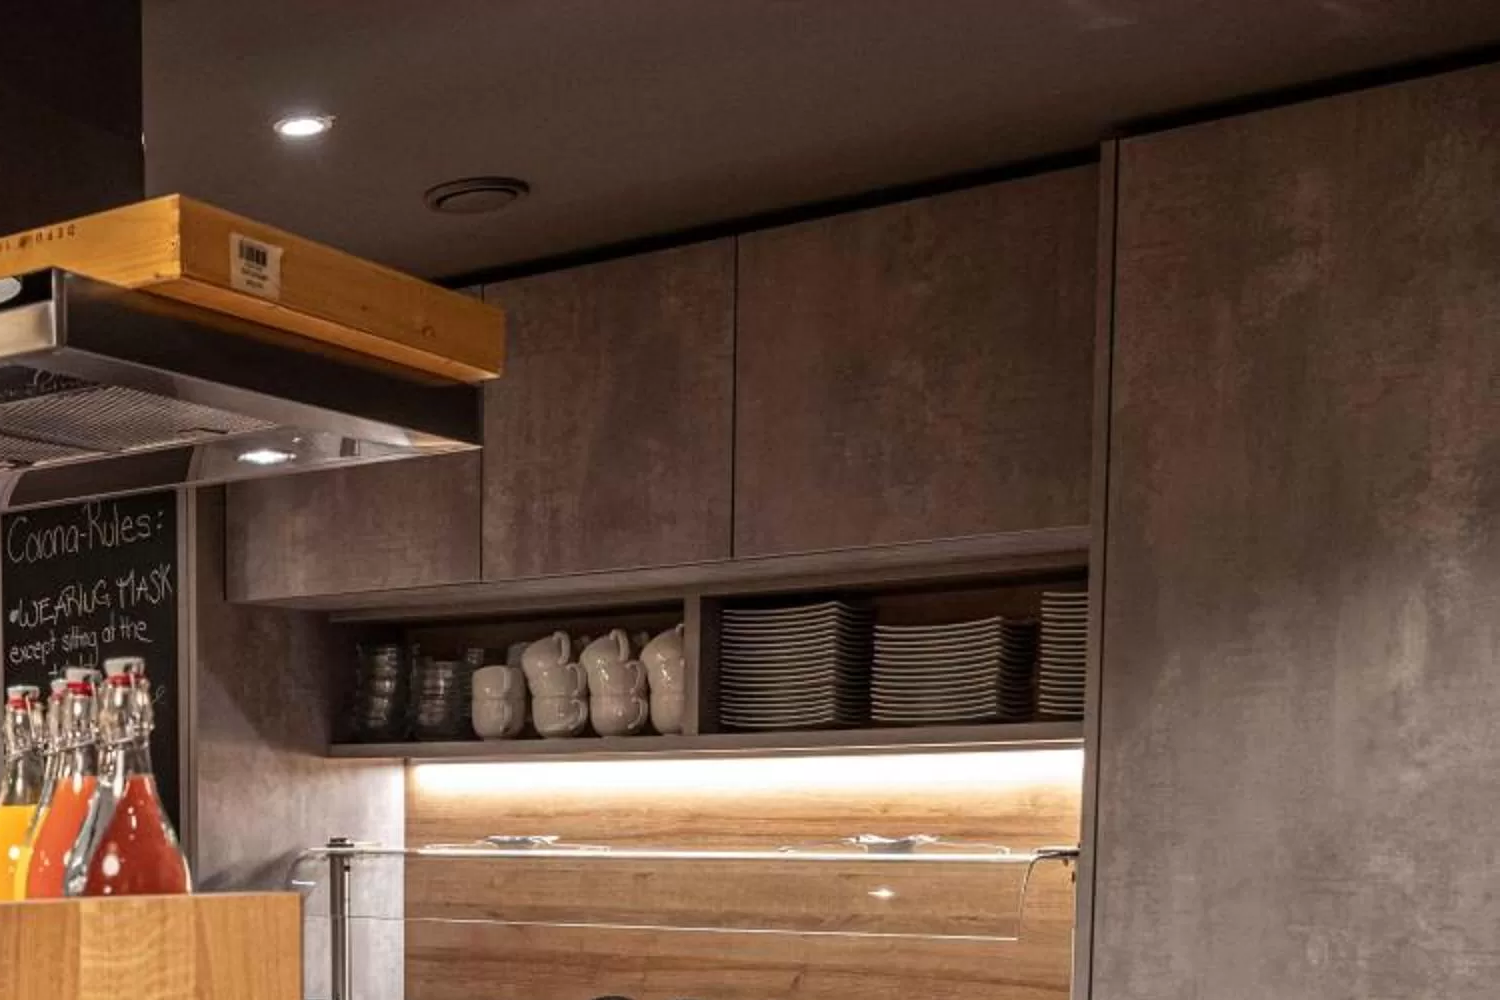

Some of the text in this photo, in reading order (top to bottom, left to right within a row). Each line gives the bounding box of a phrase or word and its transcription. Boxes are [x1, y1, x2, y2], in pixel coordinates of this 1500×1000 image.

[7, 501, 164, 563] Corona-Rules:
[116, 563, 173, 609] MASK
[9, 629, 56, 665] except
[120, 615, 152, 643] the
